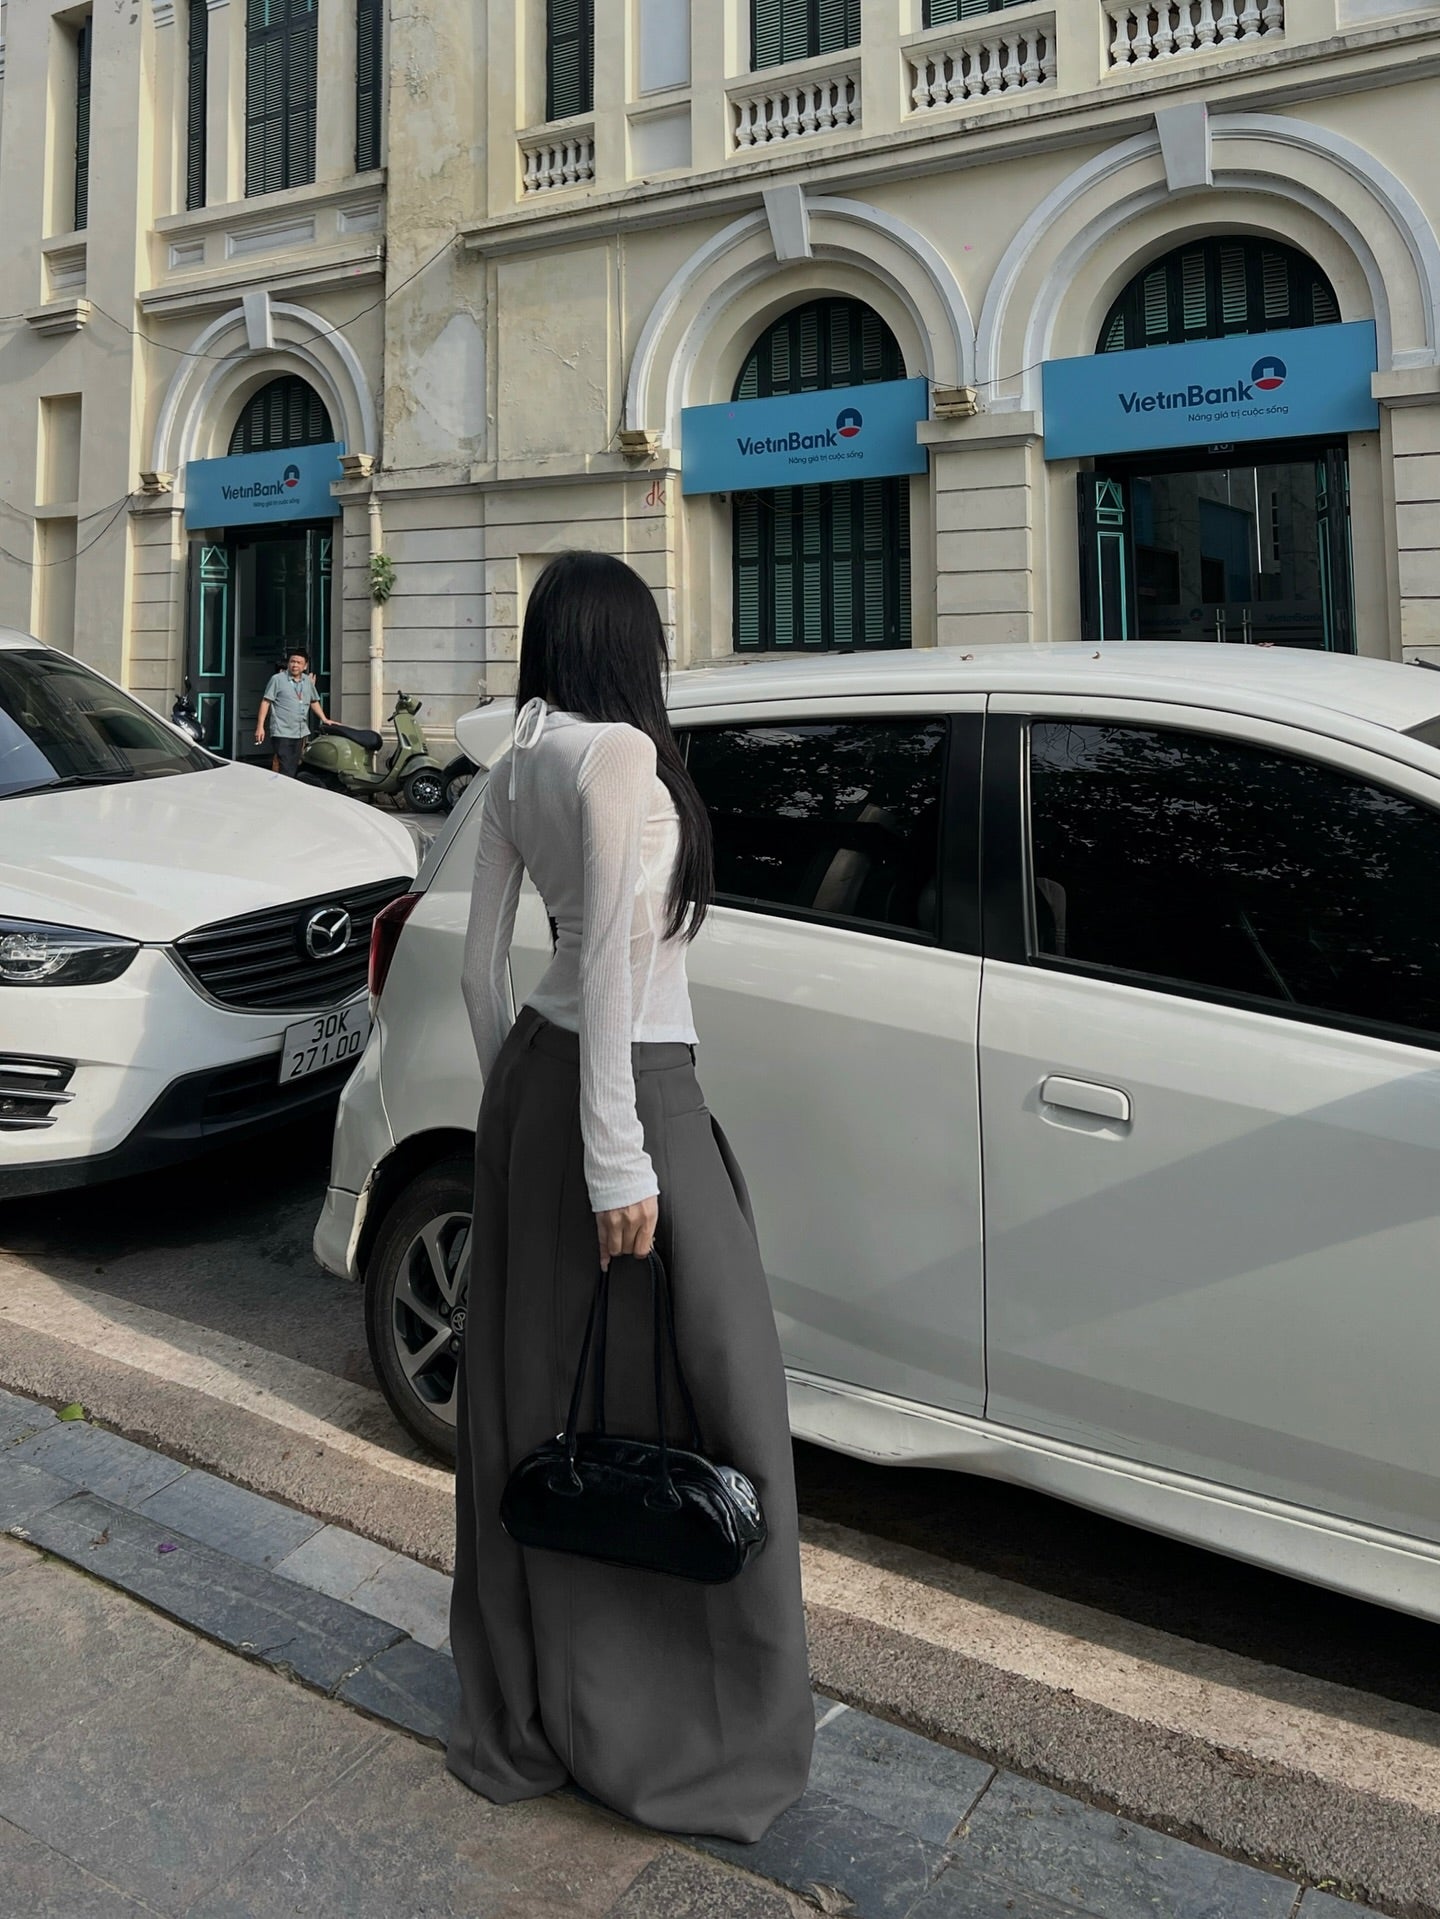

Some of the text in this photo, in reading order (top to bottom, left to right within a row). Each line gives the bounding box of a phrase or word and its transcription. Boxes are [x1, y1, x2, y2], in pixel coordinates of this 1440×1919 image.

[1118, 380, 1254, 414] VietinBank
[1214, 410, 1229, 421] giá
[1231, 409, 1240, 419] trị
[1241, 407, 1264, 417] cuộc
[1266, 404, 1289, 414] sống
[736, 428, 838, 456] VietinBank
[221, 480, 284, 500] VietinBank
[311, 1008, 352, 1043] 30K
[290, 1030, 361, 1077] 271.00
